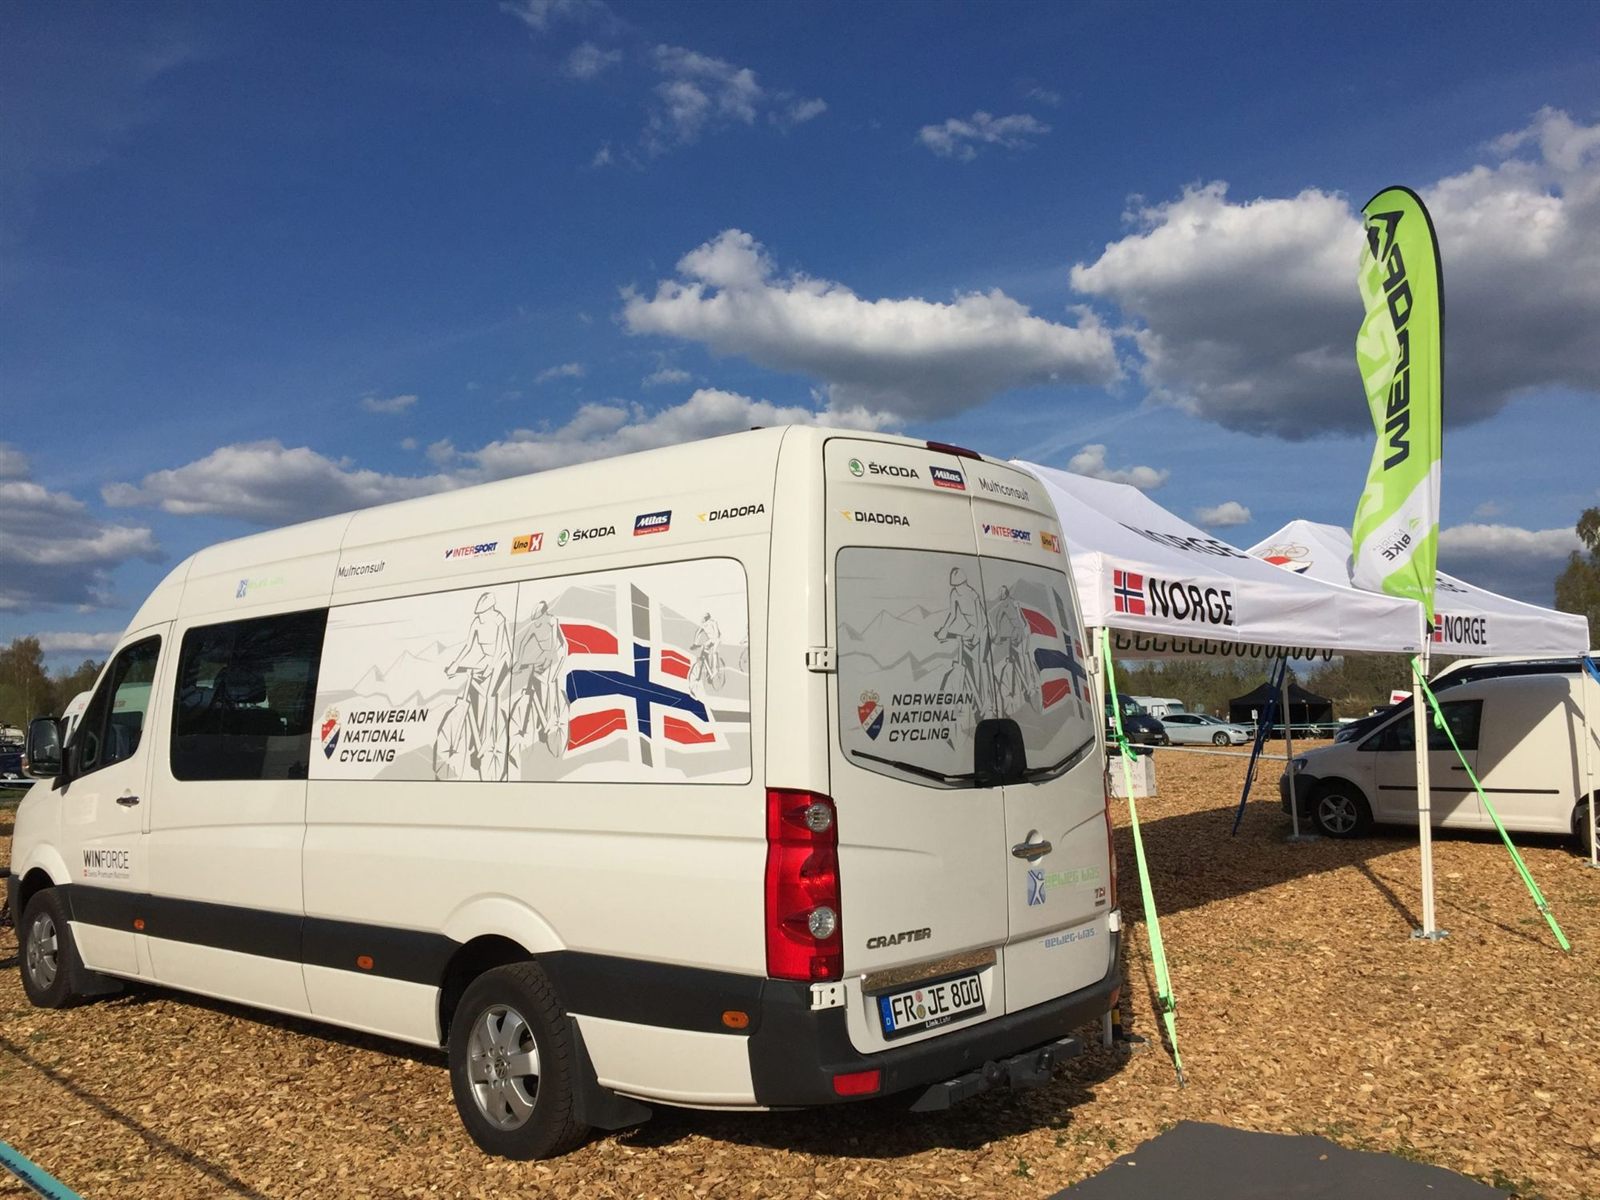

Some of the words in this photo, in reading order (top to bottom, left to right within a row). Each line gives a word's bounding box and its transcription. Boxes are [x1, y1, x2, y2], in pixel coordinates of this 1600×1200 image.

[869, 461, 920, 479] ŠKODA
[708, 503, 766, 521] DIADORA
[854, 511, 911, 527] DIADORA
[572, 525, 616, 541] ŠKODA
[991, 525, 1031, 541] INTERSPORT
[452, 541, 498, 558] INTERSPORT
[1148, 577, 1234, 626] NORGE
[1444, 615, 1487, 645] NORGE
[891, 693, 974, 706] NORWEGIAN
[347, 708, 429, 724] NORWEGIAN
[890, 709, 957, 724] NATIONAL
[343, 729, 406, 743] NATIONAL
[888, 728, 950, 742] CYCLING
[339, 749, 396, 763] CYCLING
[83, 849, 129, 869] WINFORCE
[866, 927, 932, 950] CRAFTER
[891, 995, 918, 1026] FR
[927, 986, 950, 1016] JE
[950, 978, 981, 1009] 800
